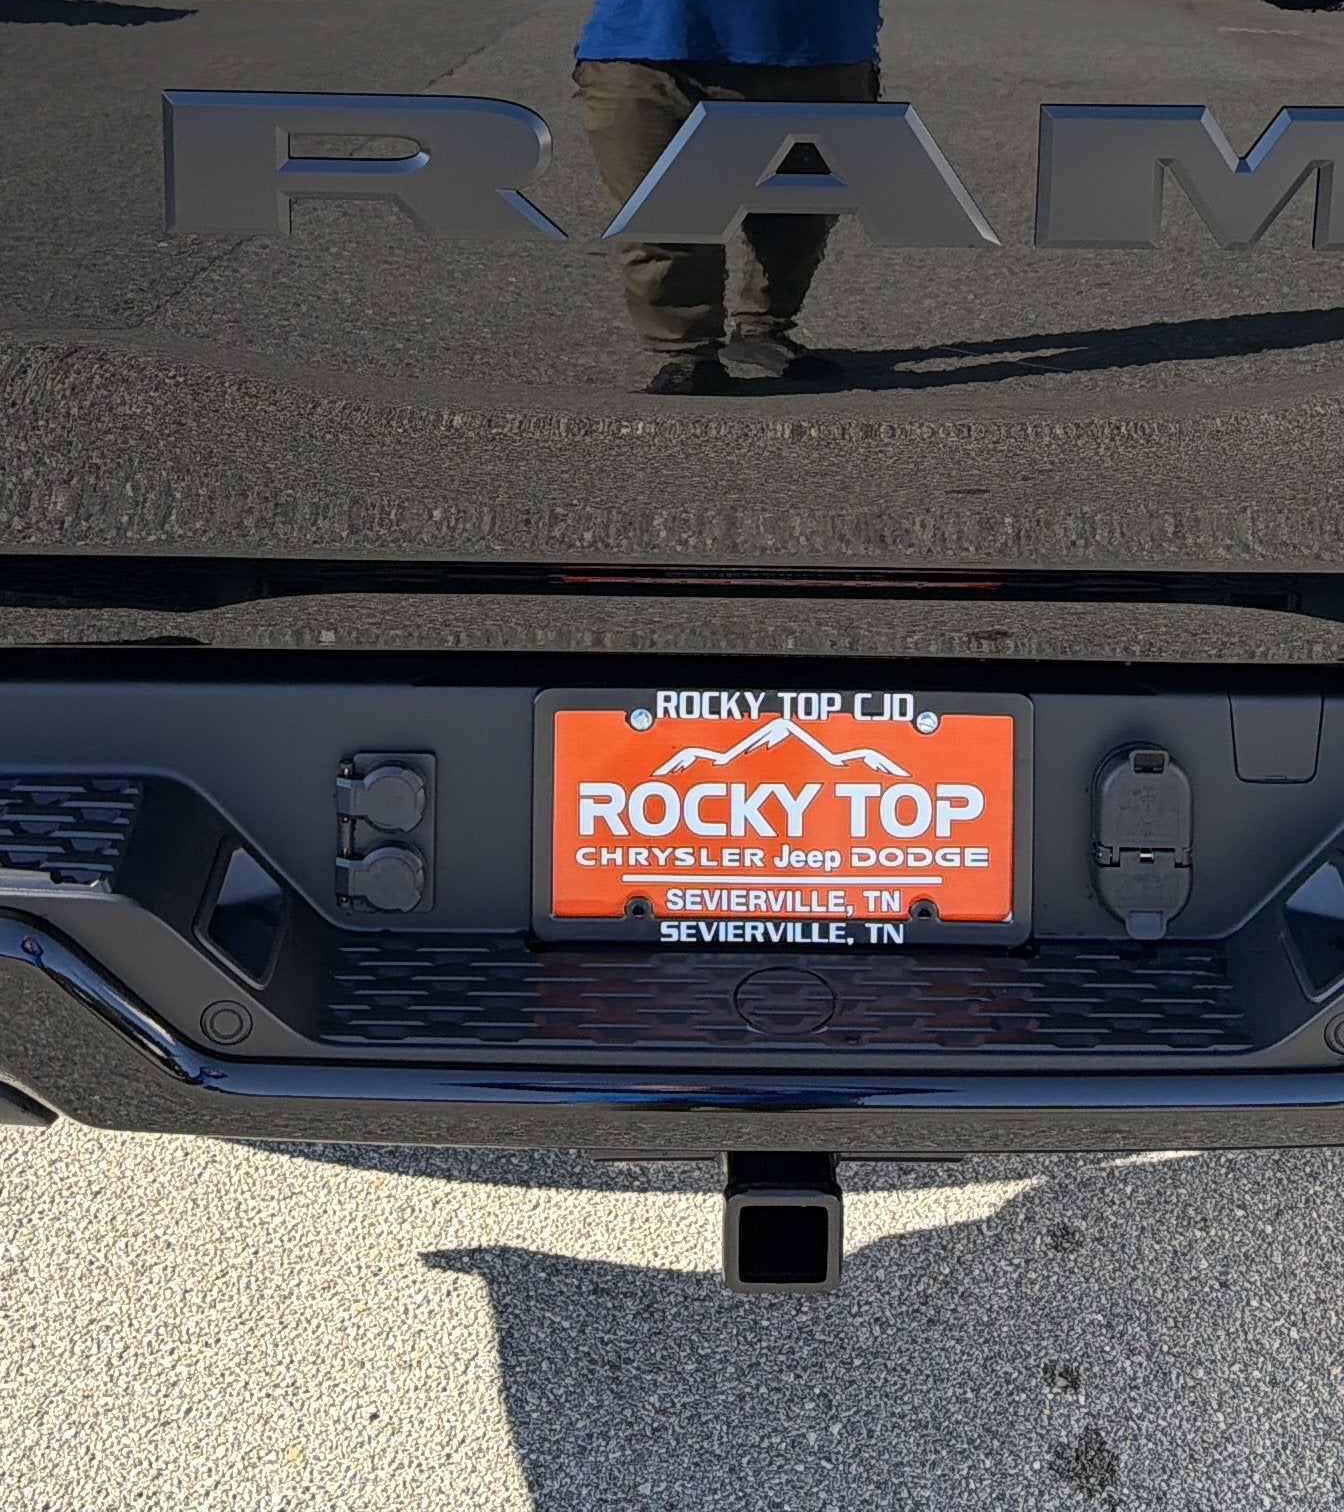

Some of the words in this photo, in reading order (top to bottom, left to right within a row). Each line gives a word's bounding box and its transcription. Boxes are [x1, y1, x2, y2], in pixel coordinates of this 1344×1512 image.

[656, 691, 766, 720] ROCKY
[777, 692, 842, 720] TOP
[854, 693, 915, 722] CJD
[577, 782, 824, 838] ROCKY
[834, 783, 986, 839] TOP
[574, 846, 765, 868] CHRYSLER
[773, 844, 842, 872] Jeep
[850, 847, 990, 868] DODGE
[664, 889, 855, 916] SEVIERVILLE,
[863, 890, 902, 913] TN
[659, 921, 855, 946] SEVIERVILLE,
[865, 922, 905, 945] TN
